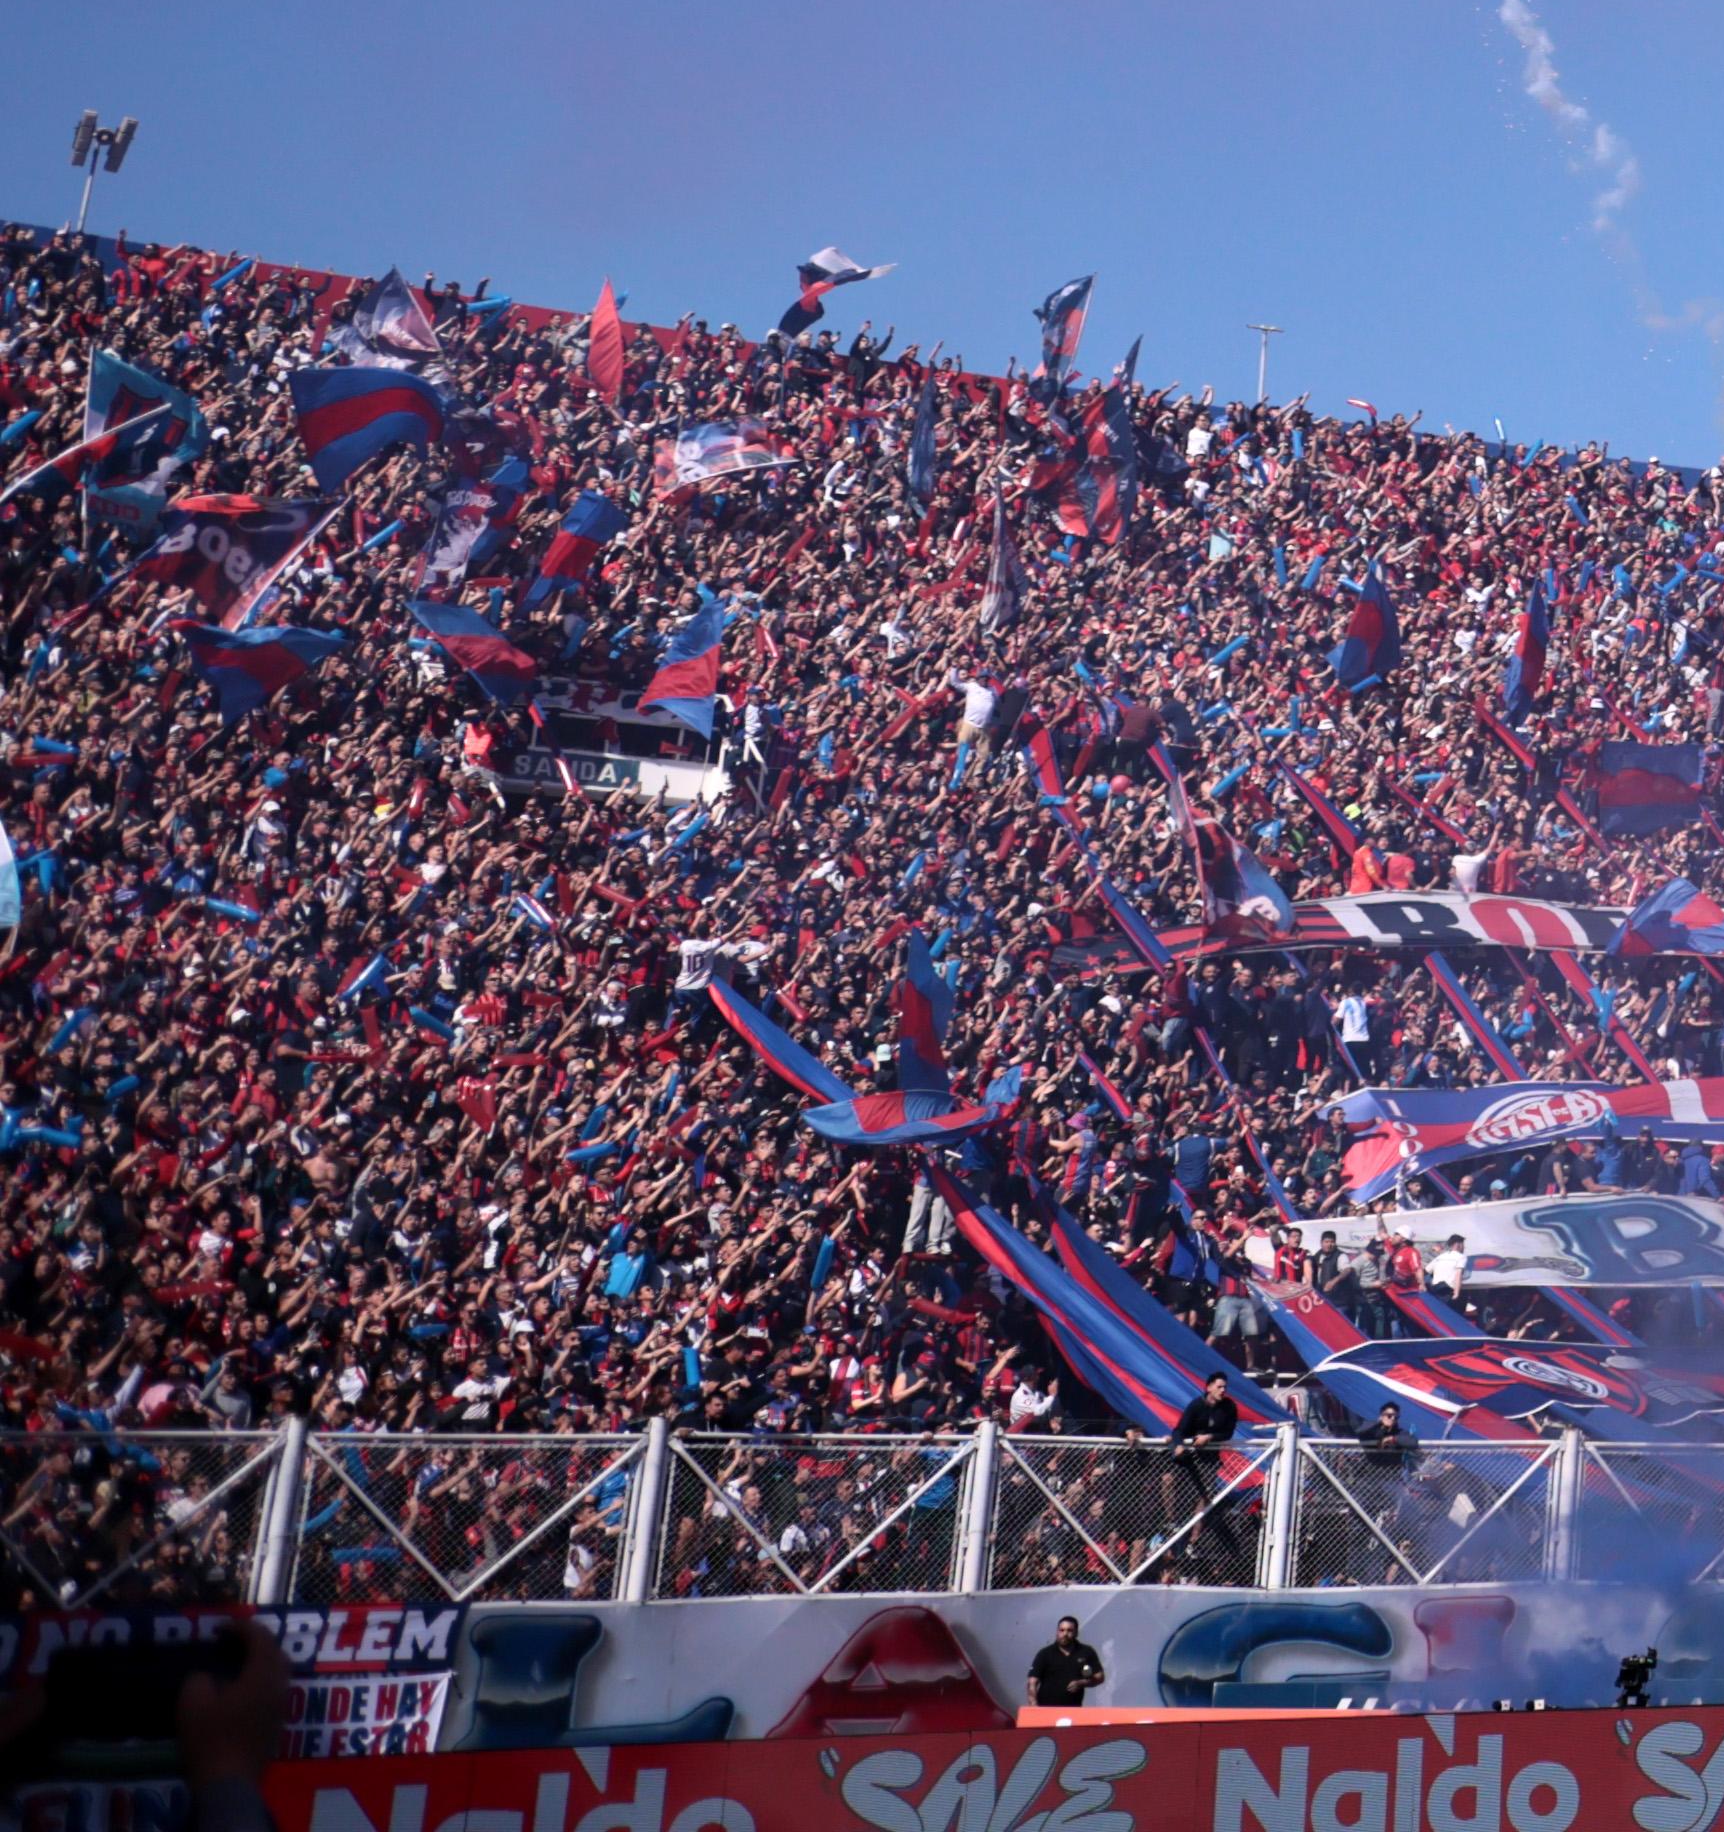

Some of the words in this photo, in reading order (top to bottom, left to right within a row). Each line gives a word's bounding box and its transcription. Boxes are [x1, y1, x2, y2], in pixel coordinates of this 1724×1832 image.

[514, 754, 617, 783] SAIDA
[154, 1609, 459, 1661] PBLEM
[286, 1680, 370, 1724] ONDE
[376, 1680, 438, 1721] HAY
[1214, 1715, 1581, 1832] Naldo
